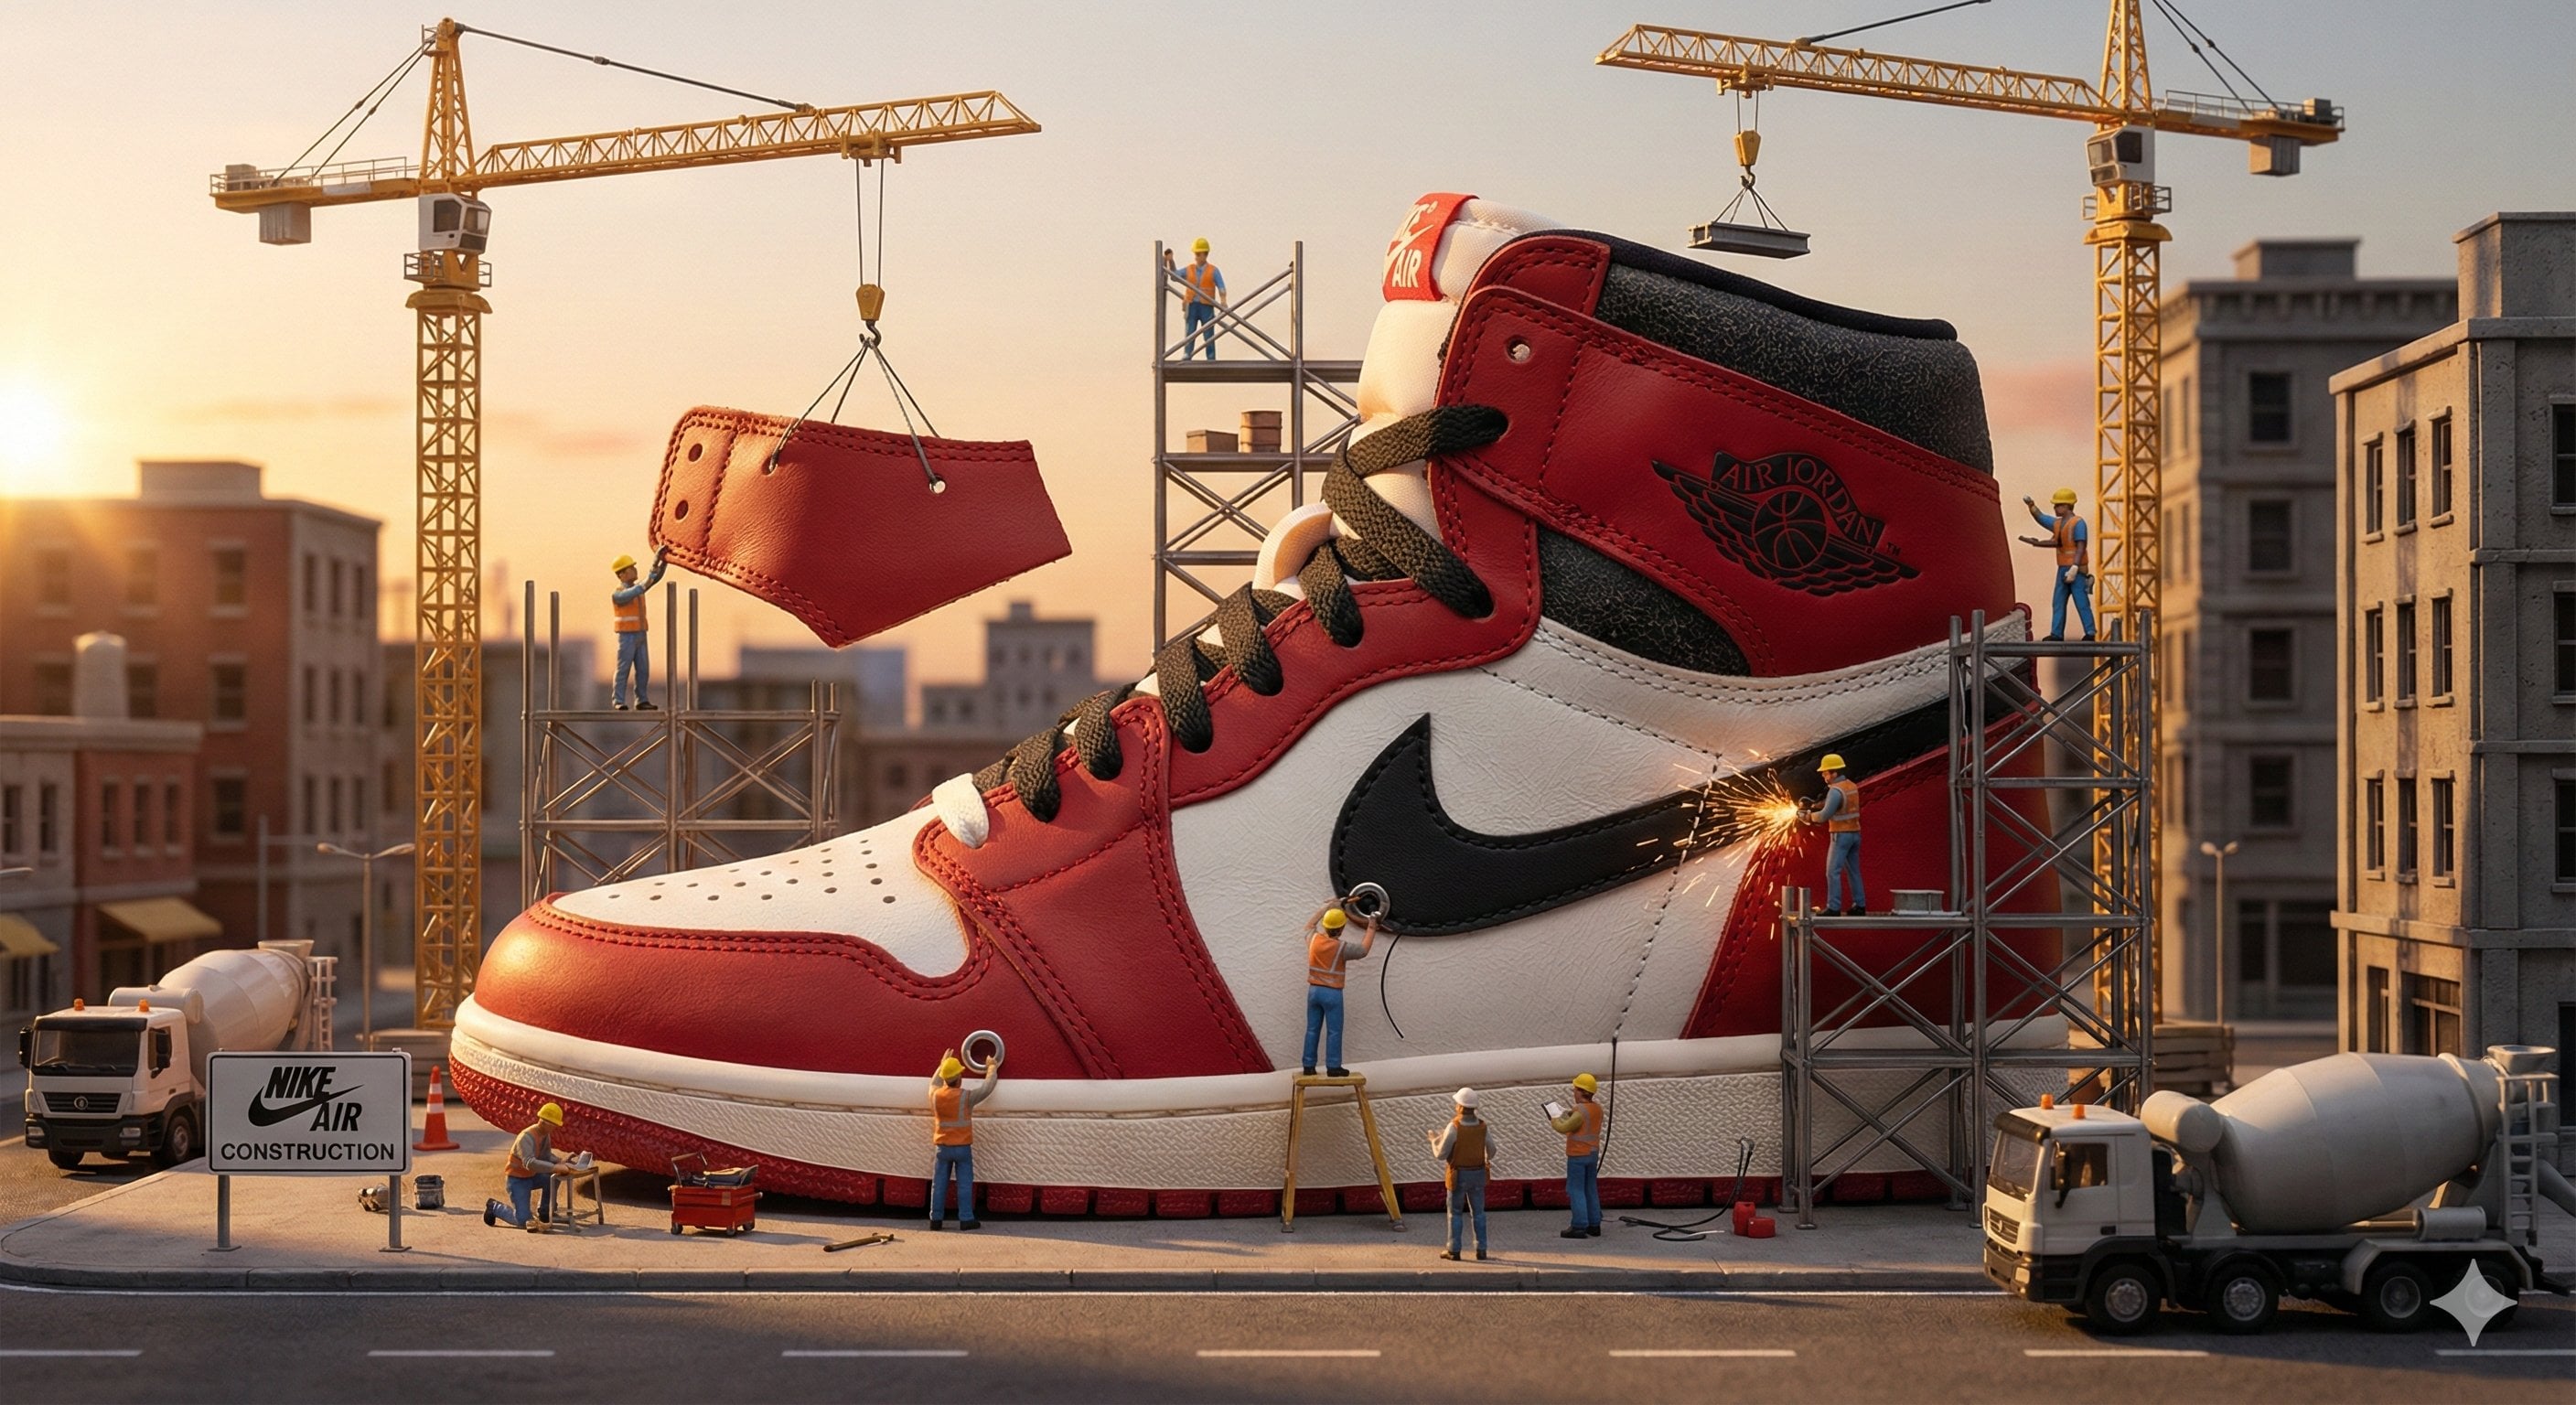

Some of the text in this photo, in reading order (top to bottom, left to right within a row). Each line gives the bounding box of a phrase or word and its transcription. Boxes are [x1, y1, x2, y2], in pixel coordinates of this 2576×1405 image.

[1391, 249, 1422, 287] AIR
[1720, 456, 1876, 547] AIR JORDAN
[263, 1067, 337, 1099] NIKE
[309, 1102, 362, 1132] AIR
[220, 1142, 394, 1161] CONSTRUCTION
